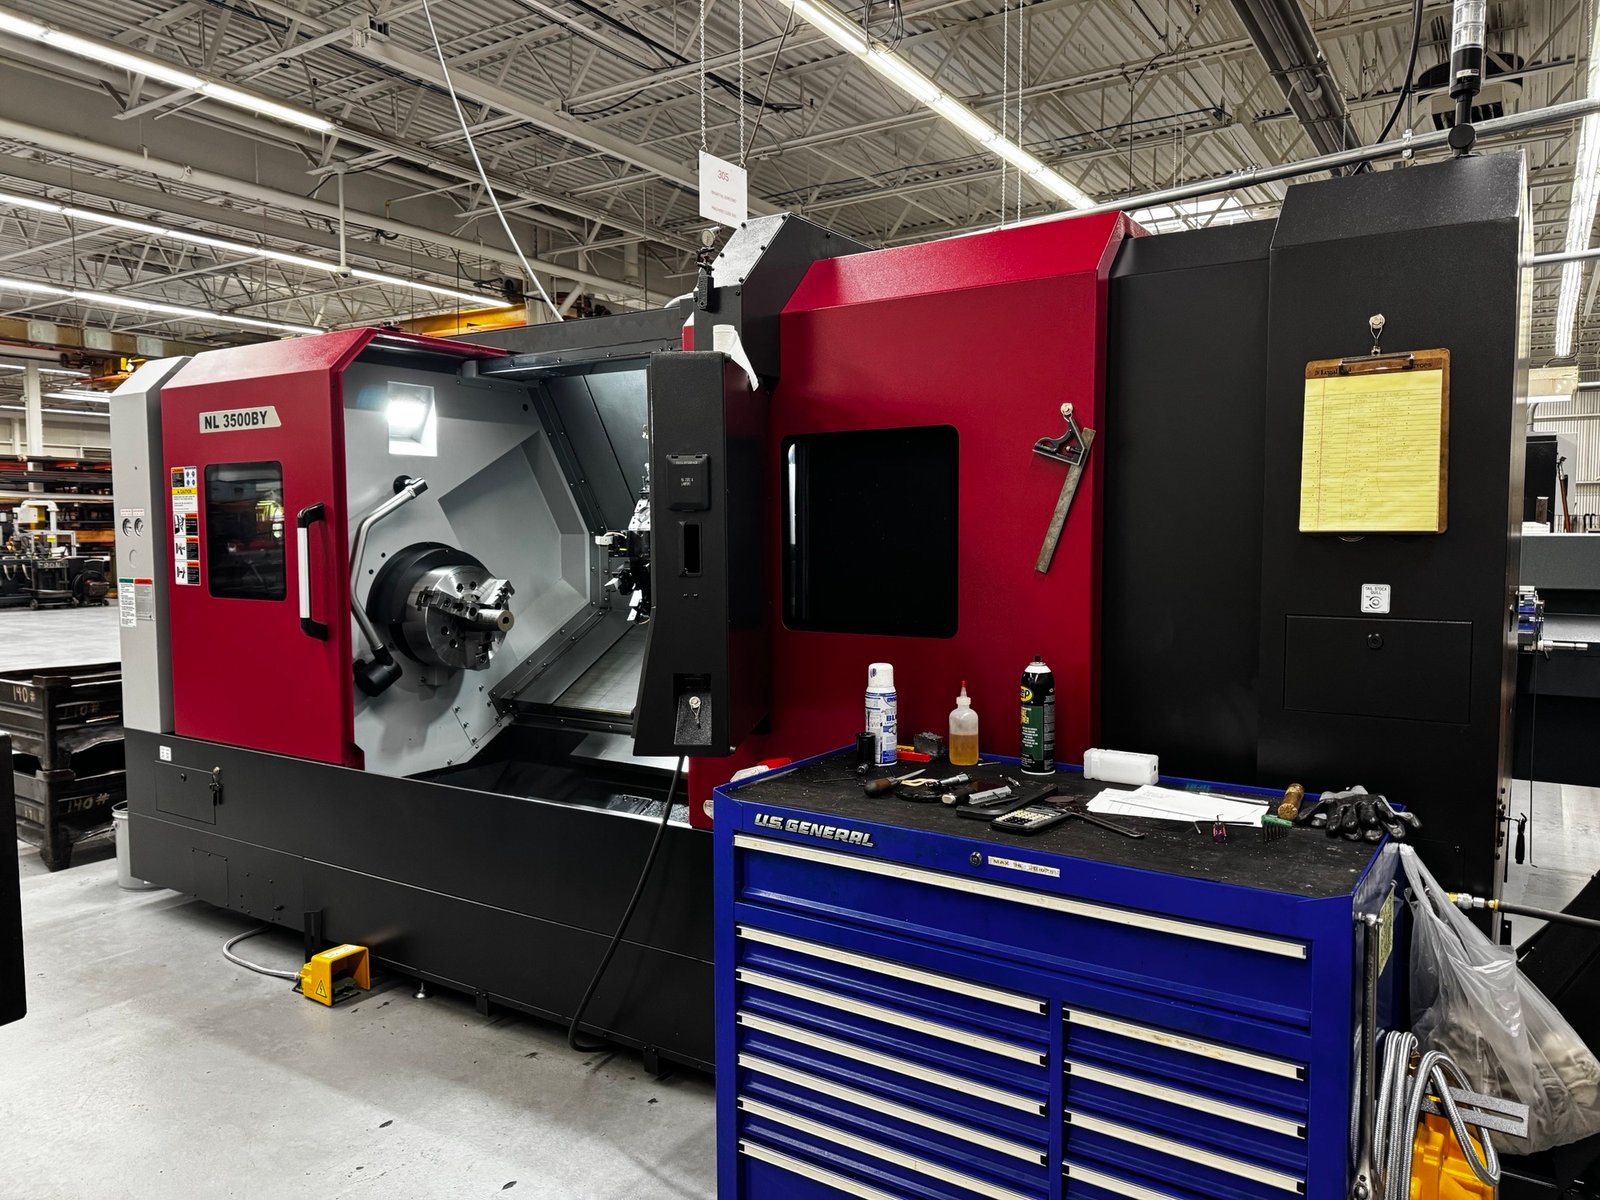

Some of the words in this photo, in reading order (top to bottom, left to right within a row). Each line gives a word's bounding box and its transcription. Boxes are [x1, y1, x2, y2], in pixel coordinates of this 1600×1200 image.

[717, 170, 729, 182] 305
[204, 415, 219, 429] NL
[223, 410, 268, 428] 3500BY
[754, 813, 783, 830] U.S.
[785, 819, 874, 848] GENERAL
